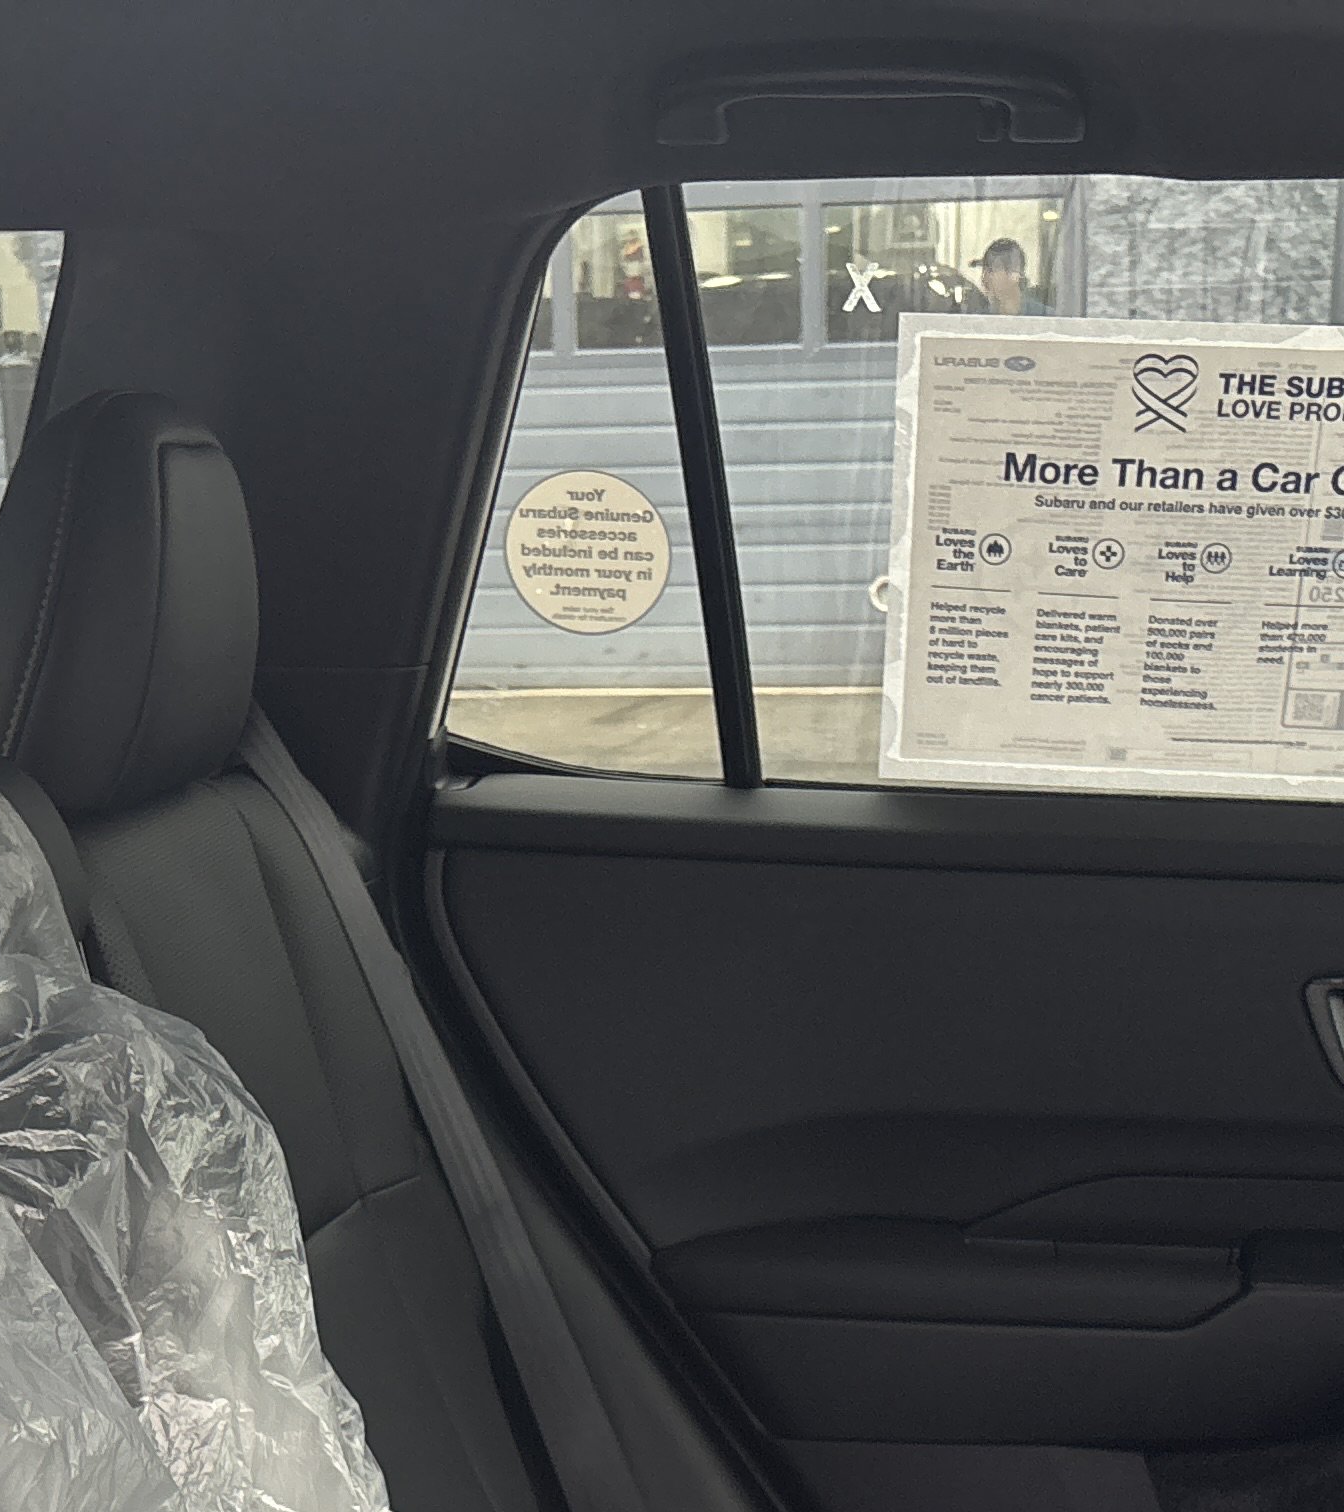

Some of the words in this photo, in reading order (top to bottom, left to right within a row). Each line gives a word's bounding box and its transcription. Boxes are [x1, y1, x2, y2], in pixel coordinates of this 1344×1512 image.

[1219, 373, 1276, 397] THE
[1217, 399, 1280, 421] LOVE
[1003, 452, 1099, 487] More
[1112, 458, 1204, 491] Than
[1216, 469, 1238, 492] a
[1251, 462, 1321, 495] Car
[1034, 495, 1085, 510] Subaru
[1089, 498, 1116, 511] and
[1119, 501, 1143, 512] our
[1147, 500, 1205, 514] retailers
[1208, 501, 1242, 515] have
[1246, 503, 1285, 518] given
[1289, 507, 1321, 519] over
[936, 534, 975, 548] Loves
[953, 547, 975, 560] the
[1048, 542, 1089, 555] Loves
[1158, 548, 1197, 561] Loves
[936, 558, 975, 572] Earth
[1073, 556, 1088, 567] to
[1289, 553, 1329, 566] Loves
[1054, 564, 1087, 578] Care
[1183, 561, 1196, 572] to
[1268, 565, 1328, 580] Learning
[1165, 571, 1195, 586] Help
[1037, 608, 1086, 620] Delivered
[1088, 613, 1118, 621] warm
[1085, 624, 1121, 634] patient
[1035, 633, 1058, 641] care
[1084, 635, 1104, 645] and
[1034, 645, 1099, 657] encouraging
[1033, 657, 1085, 668] messages
[1088, 658, 1099, 668] of
[1032, 667, 1058, 679] hope
[1060, 669, 1072, 678] to
[1074, 671, 1115, 681] support
[1031, 680, 1063, 692] nearly
[1030, 693, 1065, 702] cancer
